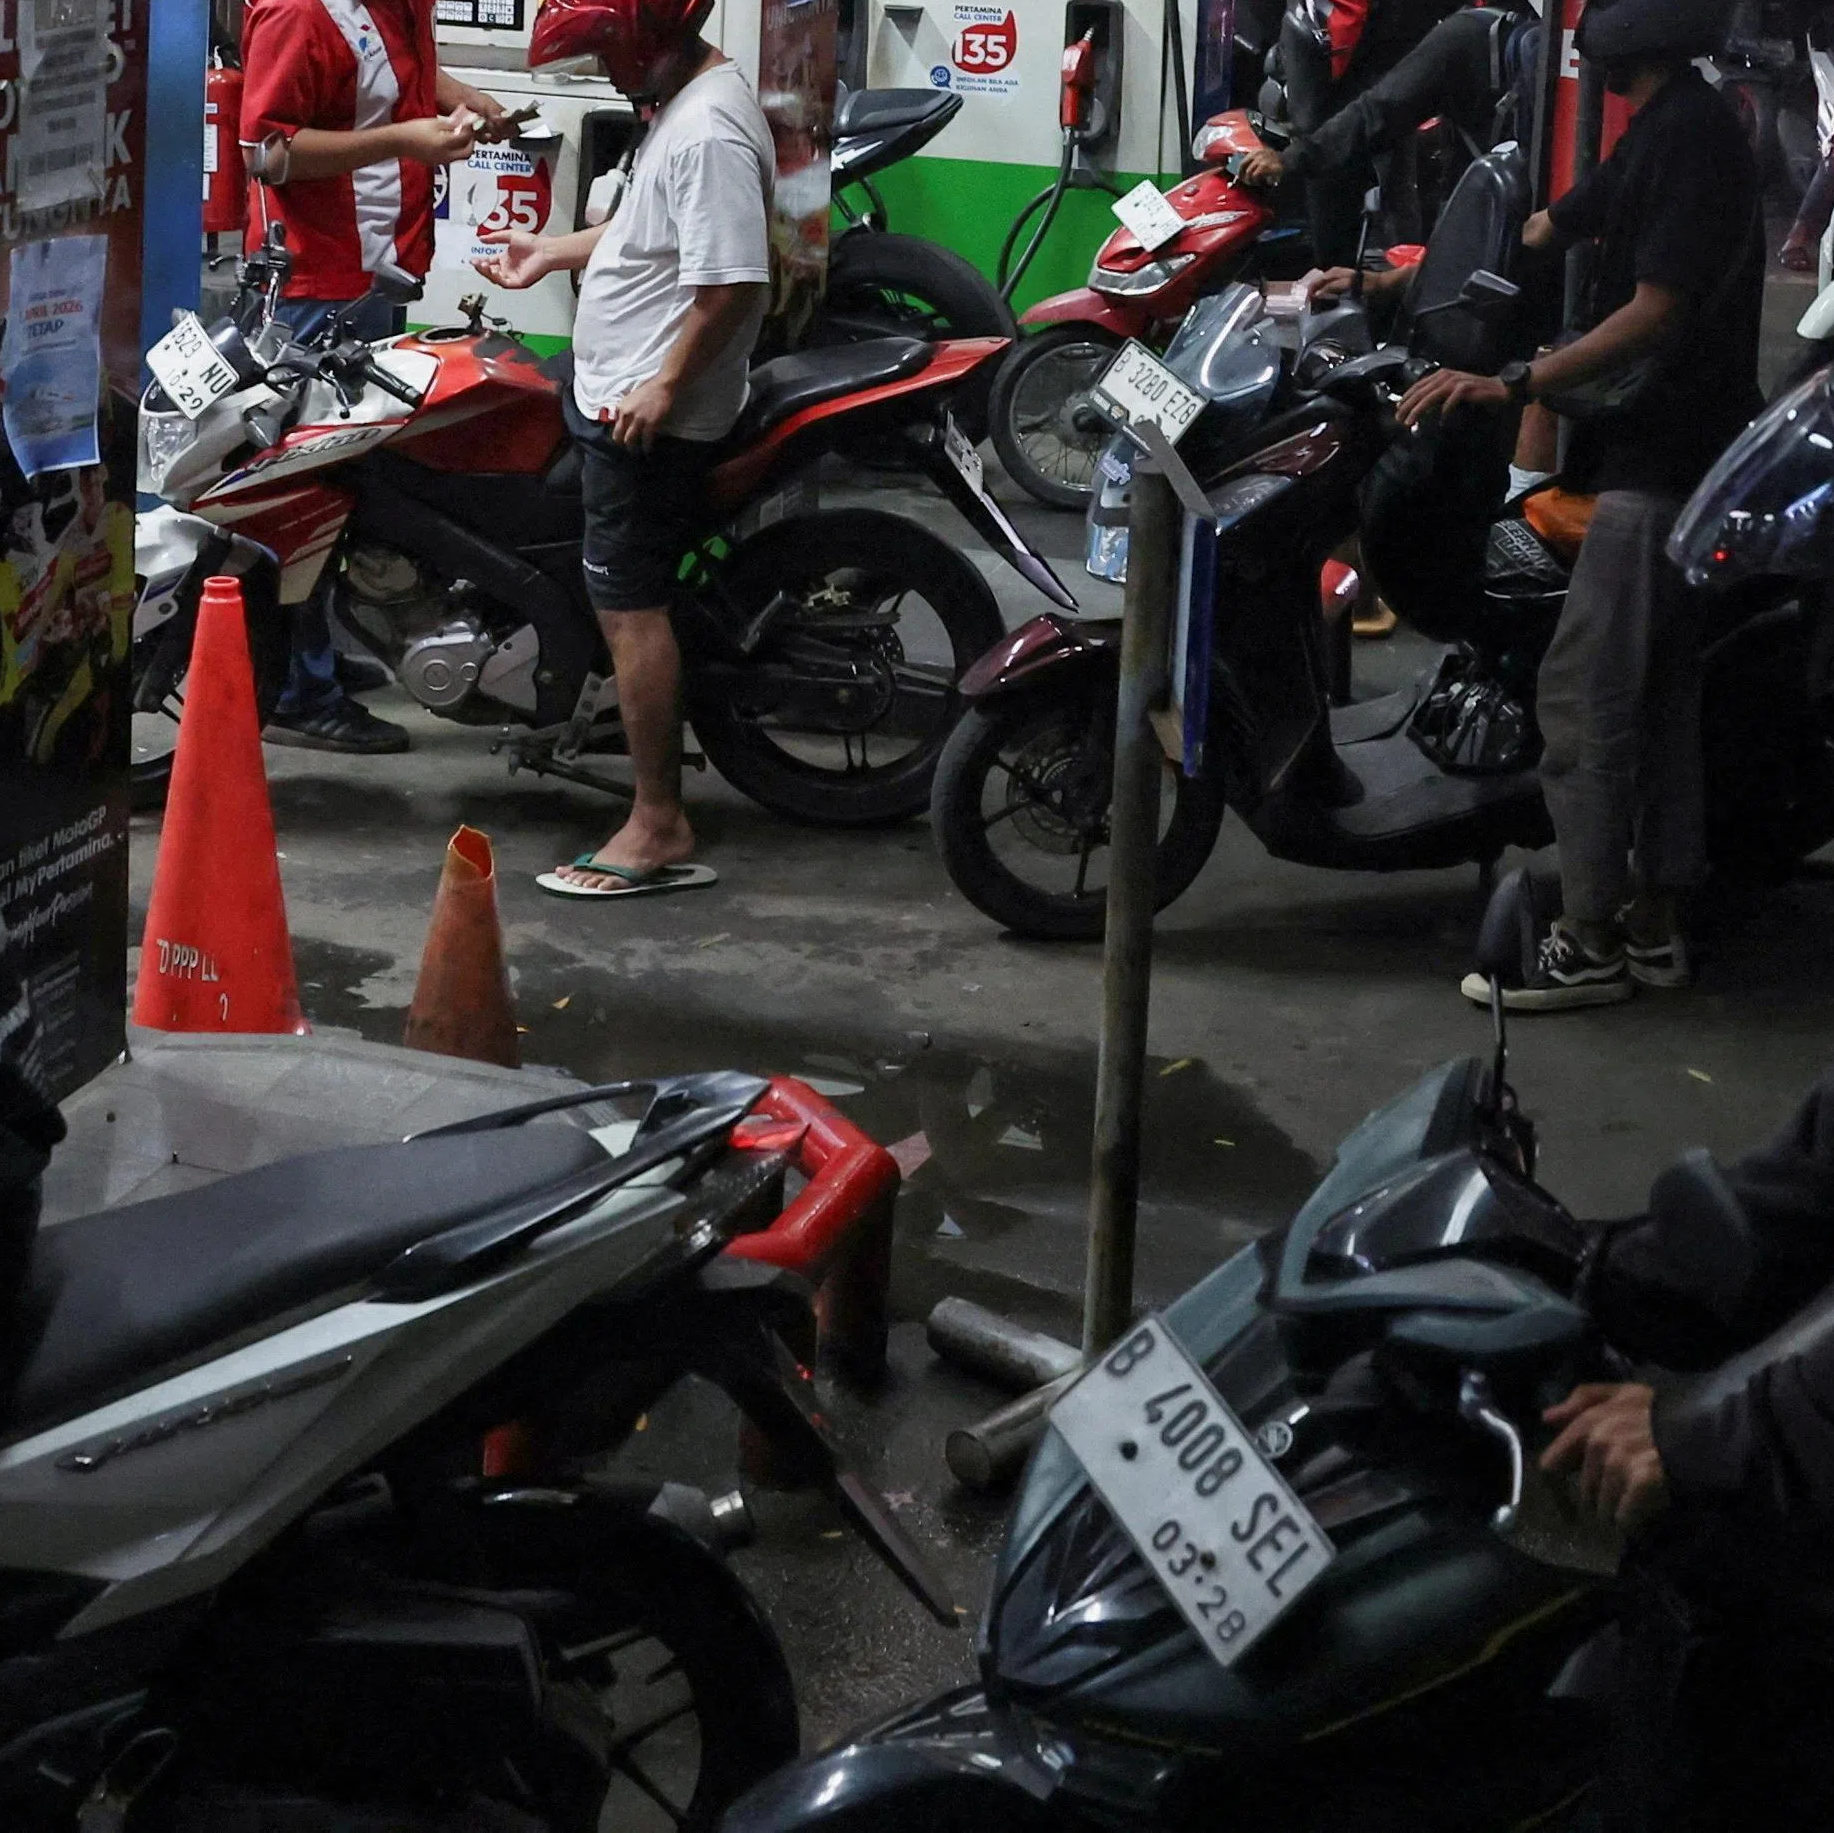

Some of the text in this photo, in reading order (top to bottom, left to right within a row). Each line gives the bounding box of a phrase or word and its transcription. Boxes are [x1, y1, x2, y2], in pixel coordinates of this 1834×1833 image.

[954, 4, 1003, 16] PERTAMINA
[954, 12, 1003, 23] CALL CENTER
[953, 33, 1009, 66] 135
[467, 160, 533, 173] CALL CENTER
[468, 149, 532, 163] PERTAMINA
[199, 361, 233, 395] NU
[1113, 351, 1132, 374] B
[1128, 361, 1169, 403] 3280
[51, 805, 107, 851] MotoGP
[1104, 1326, 1311, 1600] B 4008 SEL
